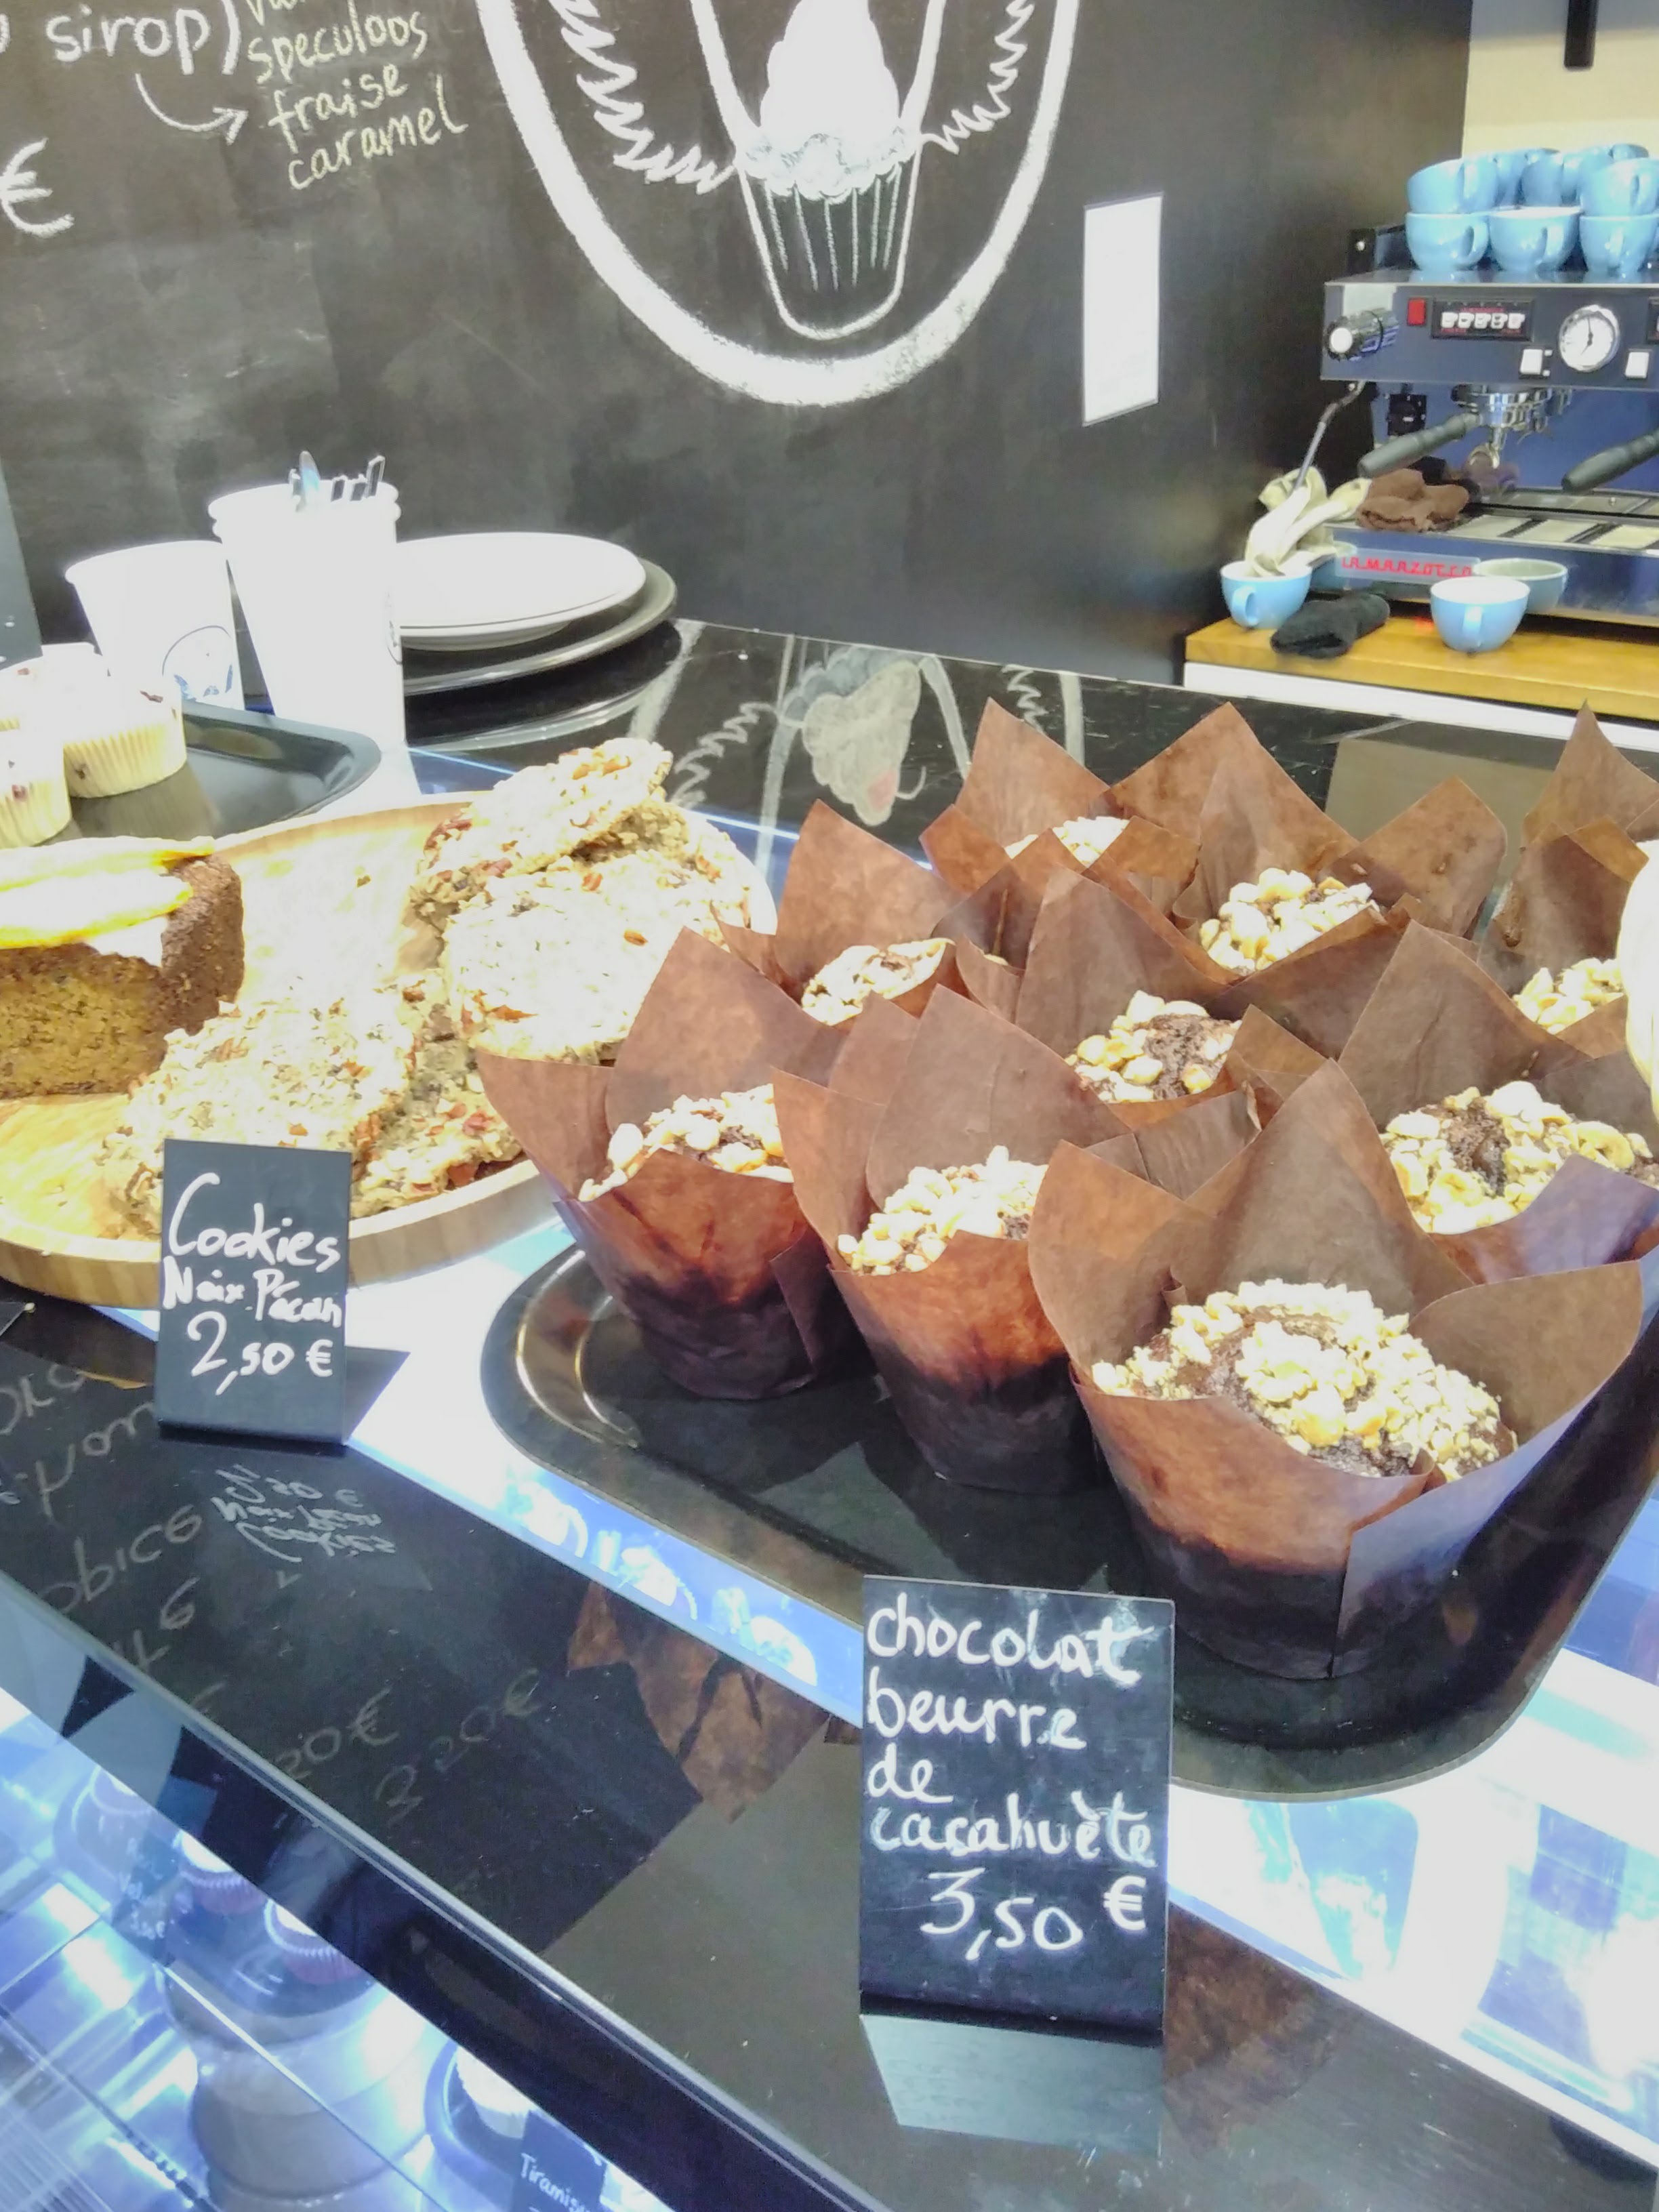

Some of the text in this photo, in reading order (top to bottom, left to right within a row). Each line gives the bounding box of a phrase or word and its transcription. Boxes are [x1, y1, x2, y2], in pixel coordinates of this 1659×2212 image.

[247, 0, 428, 83] speculoos
[268, 64, 409, 153] fraise
[288, 74, 468, 190] caramel
[169, 1172, 341, 1273] Cookies
[187, 1311, 334, 1395] 2,50 €
[867, 1592, 1155, 1686] chocolat
[867, 1666, 1087, 1750] beurre
[867, 1743, 954, 1803] de
[869, 1791, 1158, 1868] cacahuète
[920, 1867, 1147, 1961] 3,50 €
